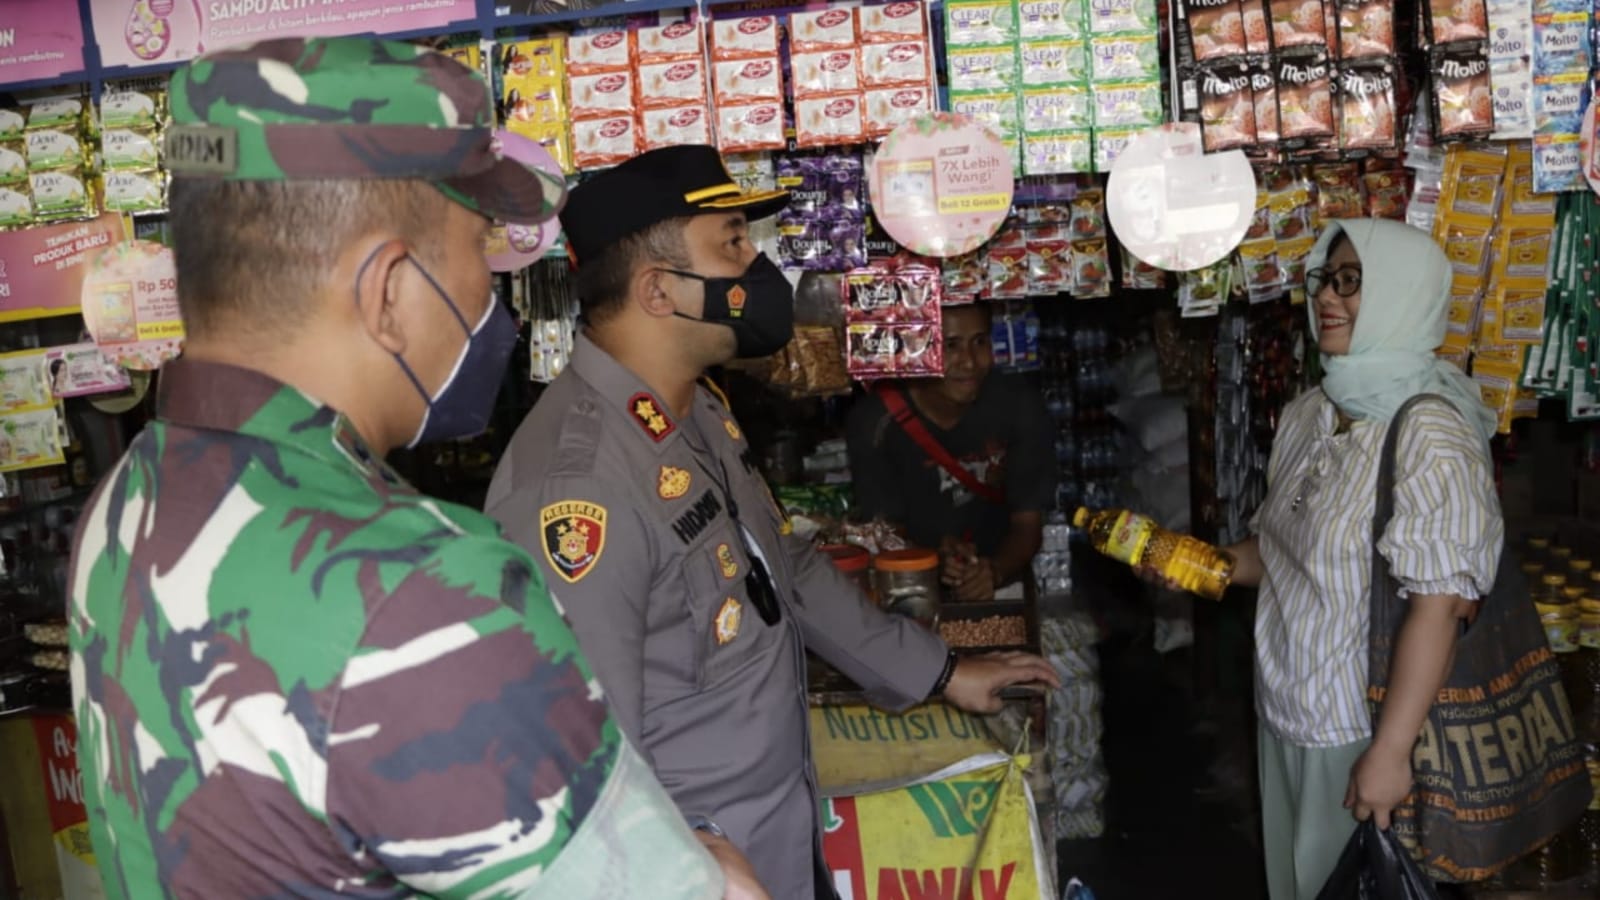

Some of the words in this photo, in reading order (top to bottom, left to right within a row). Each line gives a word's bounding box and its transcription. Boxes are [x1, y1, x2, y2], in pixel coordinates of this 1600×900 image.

[210, 0, 268, 20] SAMPO
[950, 9, 989, 22] CLEAR
[1021, 2, 1059, 16] CLEAR
[1545, 33, 1578, 46] Molto
[1095, 43, 1134, 56] CLEAR
[953, 54, 992, 68] CLEAR
[1545, 94, 1578, 107] Molto
[30, 134, 58, 146] Dove
[1099, 139, 1128, 152] CLEA
[942, 159, 958, 172] 7X
[963, 156, 1000, 170] Lebih
[1545, 154, 1578, 167] Molto
[35, 176, 62, 188] Dove
[107, 176, 135, 187] Dove
[947, 170, 992, 184] Wangi
[791, 190, 827, 203] Downy
[33, 243, 74, 265] PRODUK
[75, 233, 109, 250] BARU
[866, 242, 896, 253] owny
[137, 280, 156, 293] Rp
[822, 704, 939, 741] Nutrisi
